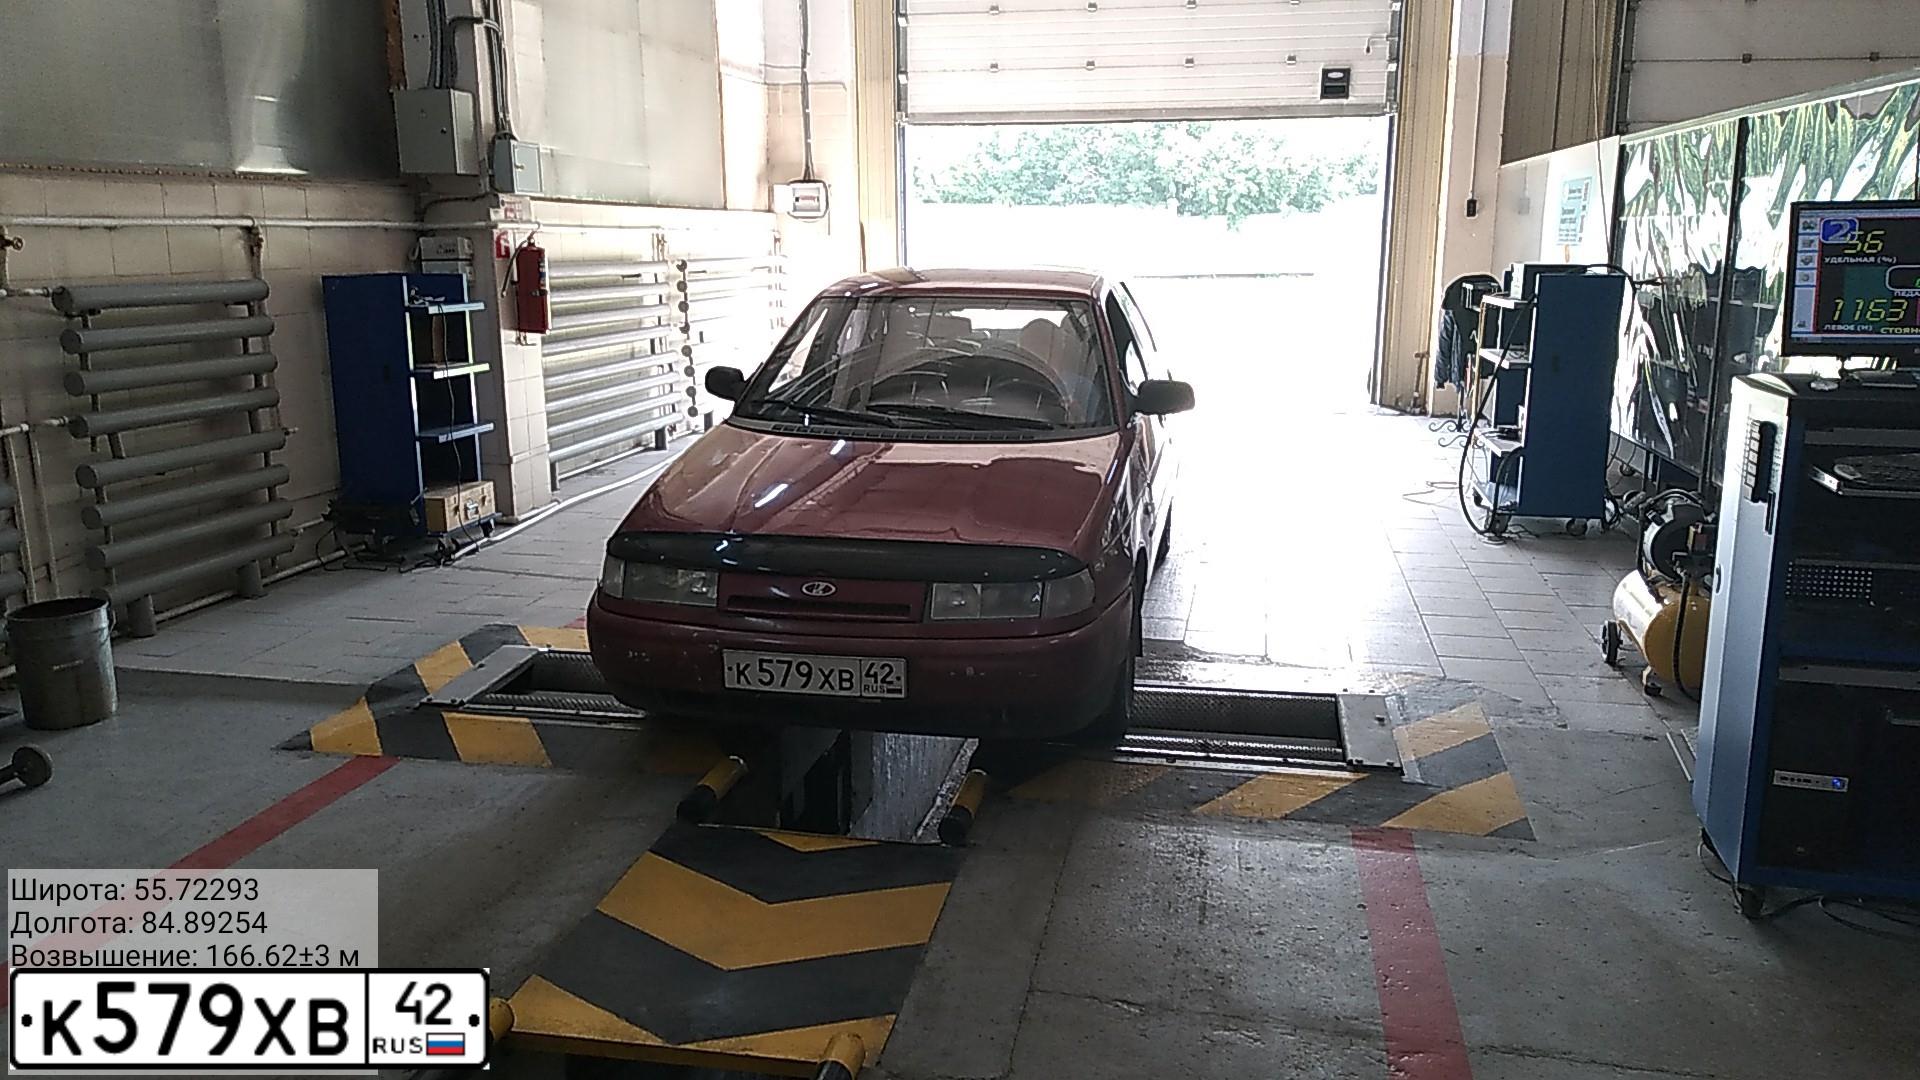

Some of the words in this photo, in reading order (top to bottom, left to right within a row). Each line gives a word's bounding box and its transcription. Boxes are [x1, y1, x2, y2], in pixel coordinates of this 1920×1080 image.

[1843, 230, 1885, 253] 56
[1824, 256, 1875, 264] УДЕЛЬНАЯ
[1833, 299, 1908, 321] 1163
[864, 662, 894, 685] 42
[863, 684, 886, 694] RUS
